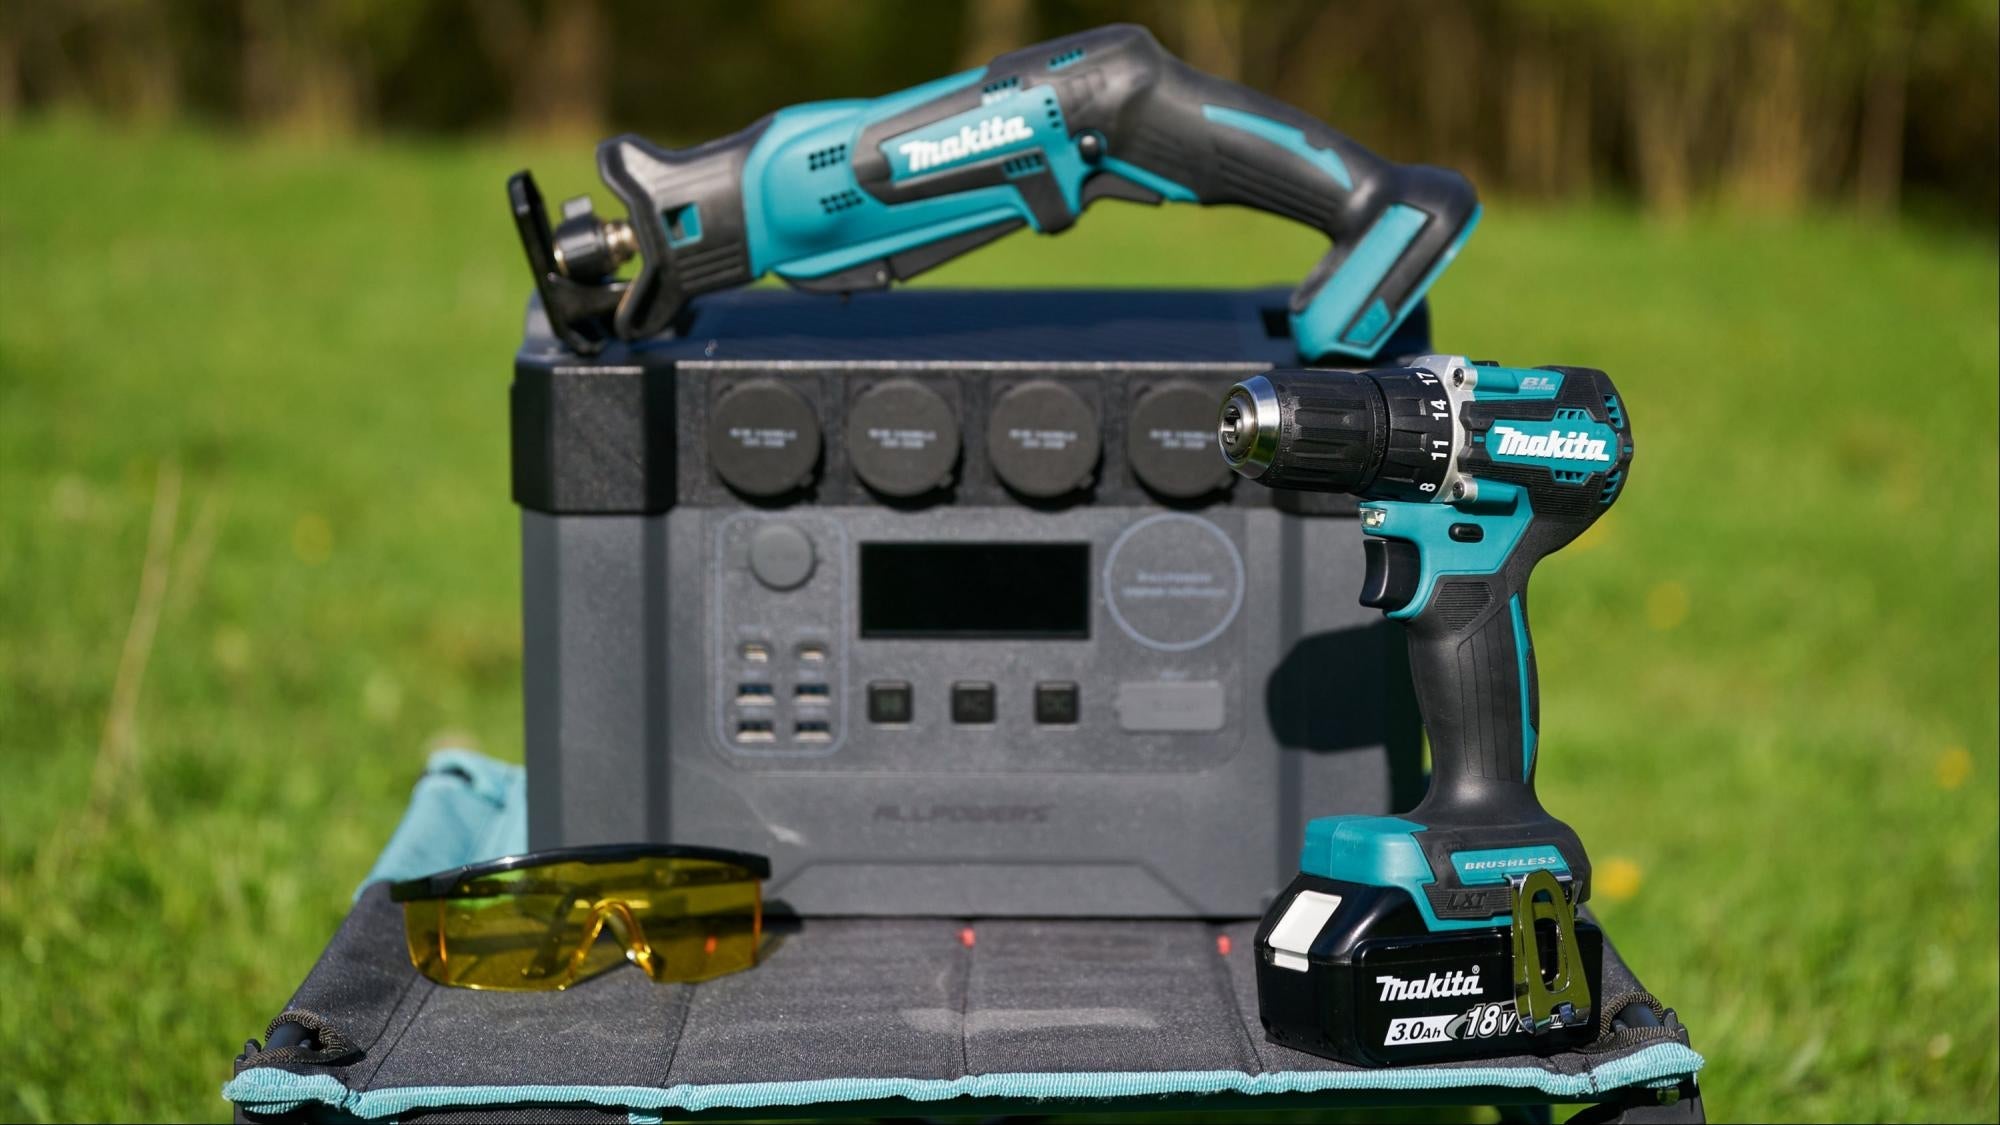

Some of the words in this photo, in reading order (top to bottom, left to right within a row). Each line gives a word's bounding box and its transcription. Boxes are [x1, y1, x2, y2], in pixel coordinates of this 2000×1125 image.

[899, 115, 1034, 172] Makita
[1416, 371, 1438, 386] 17
[1430, 399, 1449, 421] 14
[1430, 440, 1449, 461] 11
[1494, 426, 1610, 462] Makita
[1419, 482, 1437, 493] 8
[1465, 856, 1557, 870] BRUSHLESS
[1448, 892, 1488, 910] LXT
[1391, 1019, 1442, 1042] 3.0Ah
[1464, 1003, 1515, 1039] 18V
